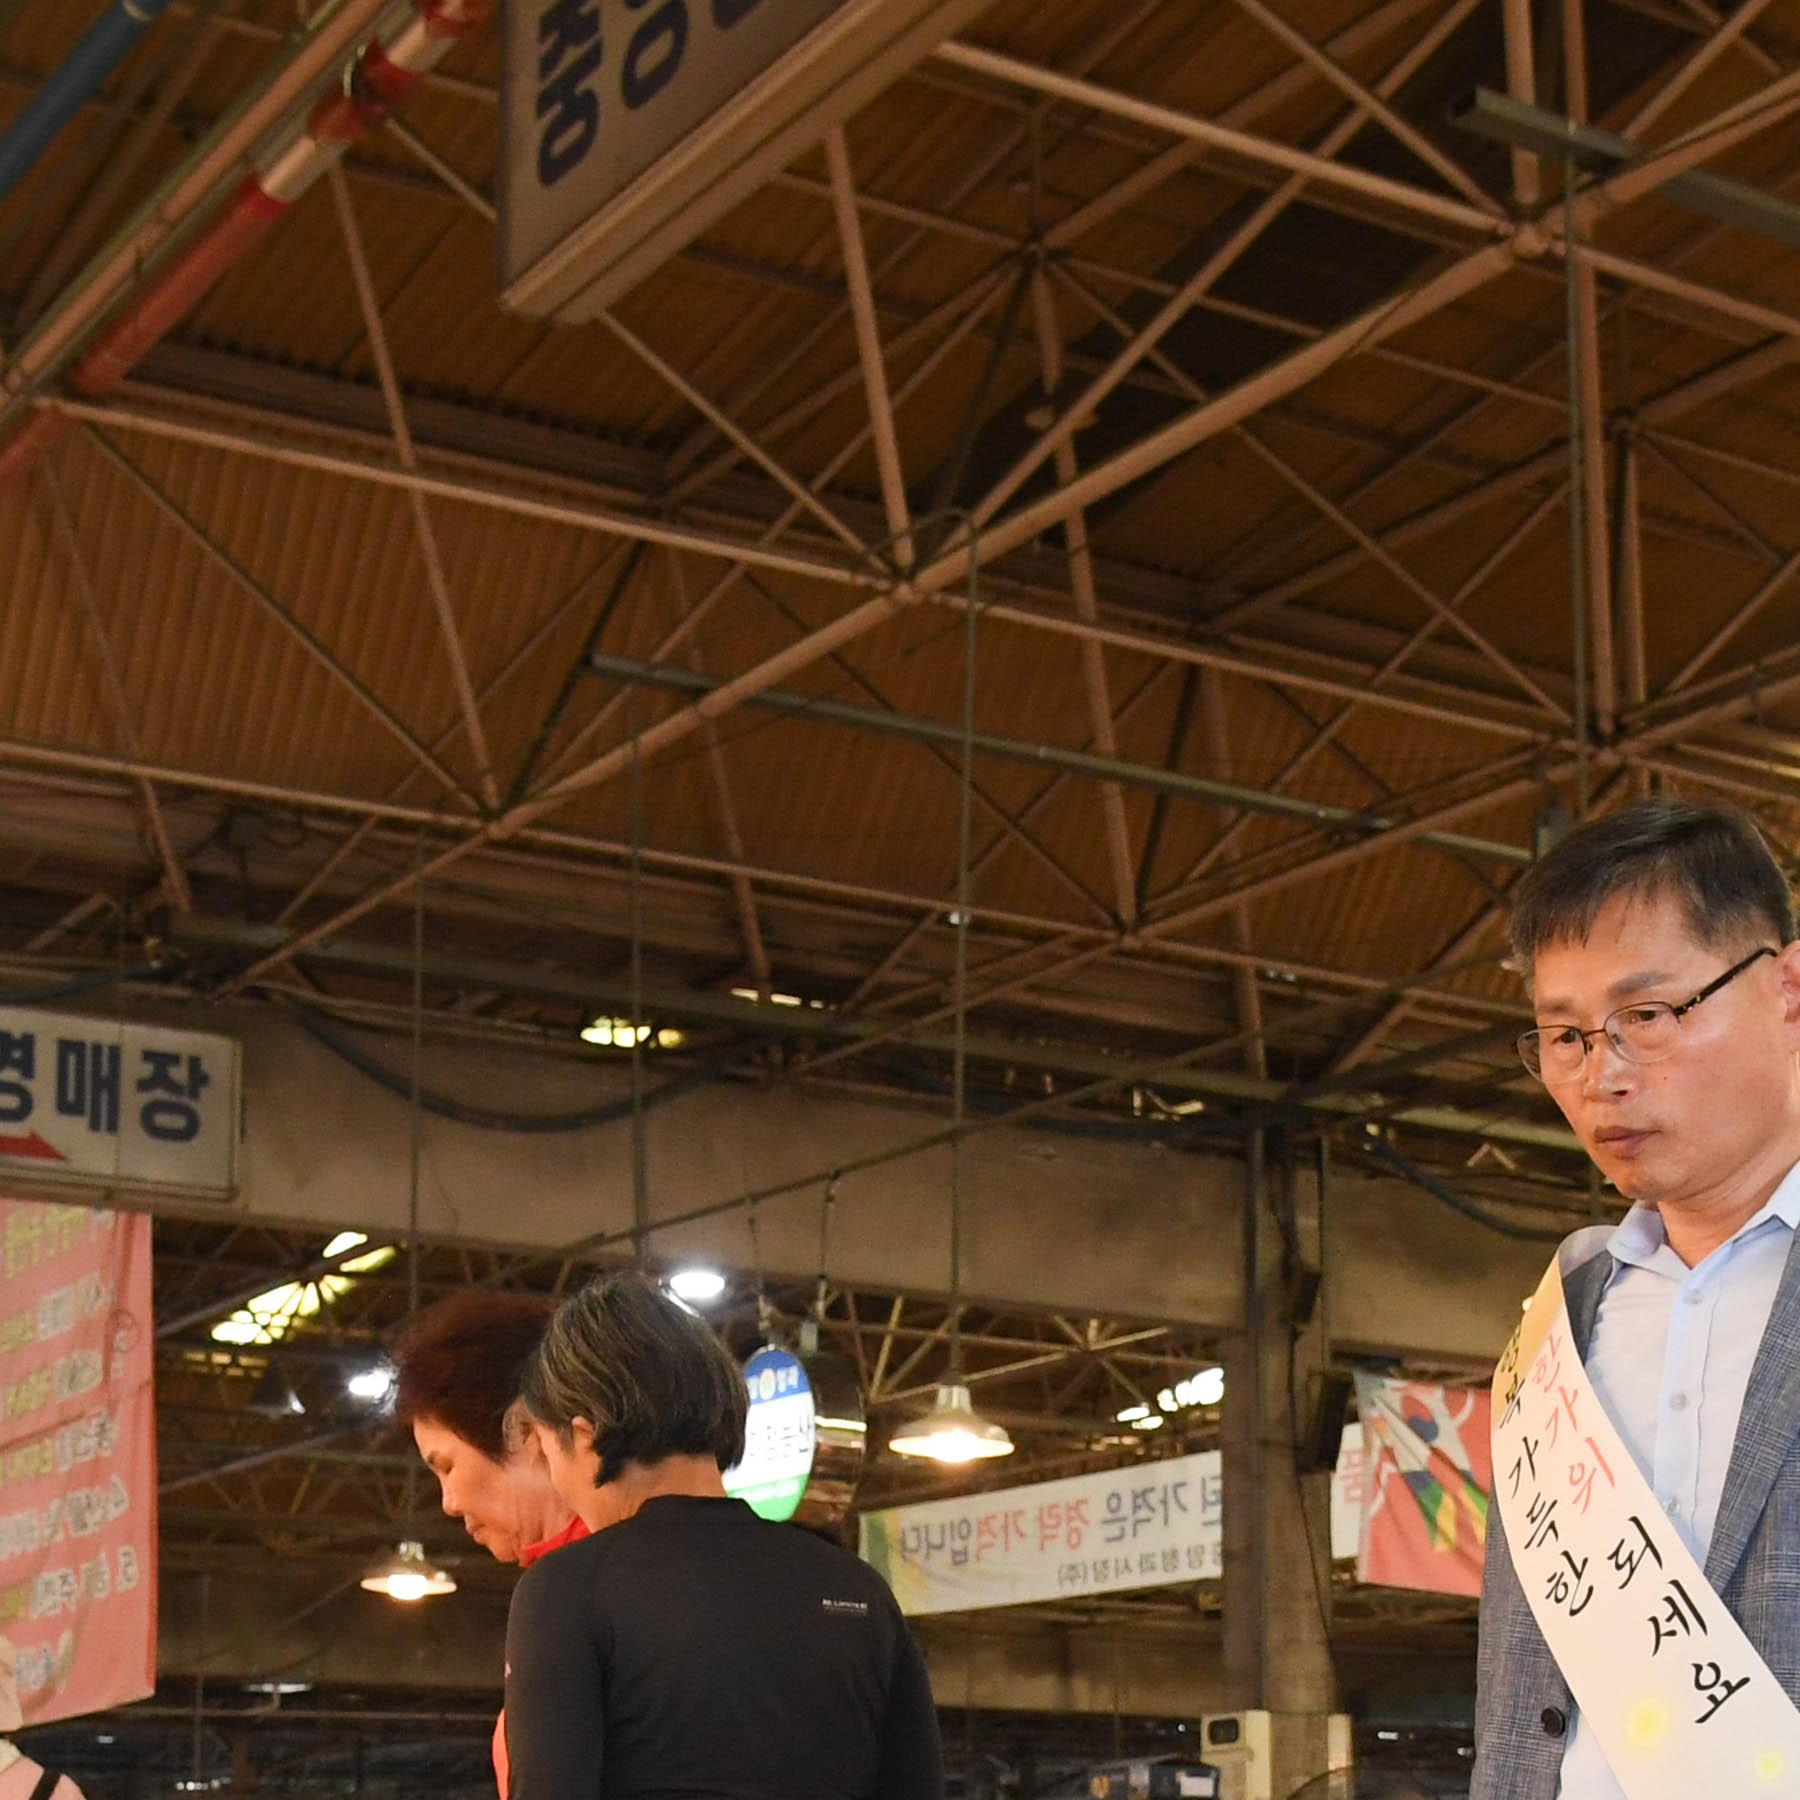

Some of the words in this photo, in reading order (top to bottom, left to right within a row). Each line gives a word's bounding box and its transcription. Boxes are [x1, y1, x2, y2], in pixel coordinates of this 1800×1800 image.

[1508, 1436, 1594, 1618] 가득한
[1531, 1333, 1615, 1515] 한가위
[1606, 1515, 1751, 1725] 되세요
